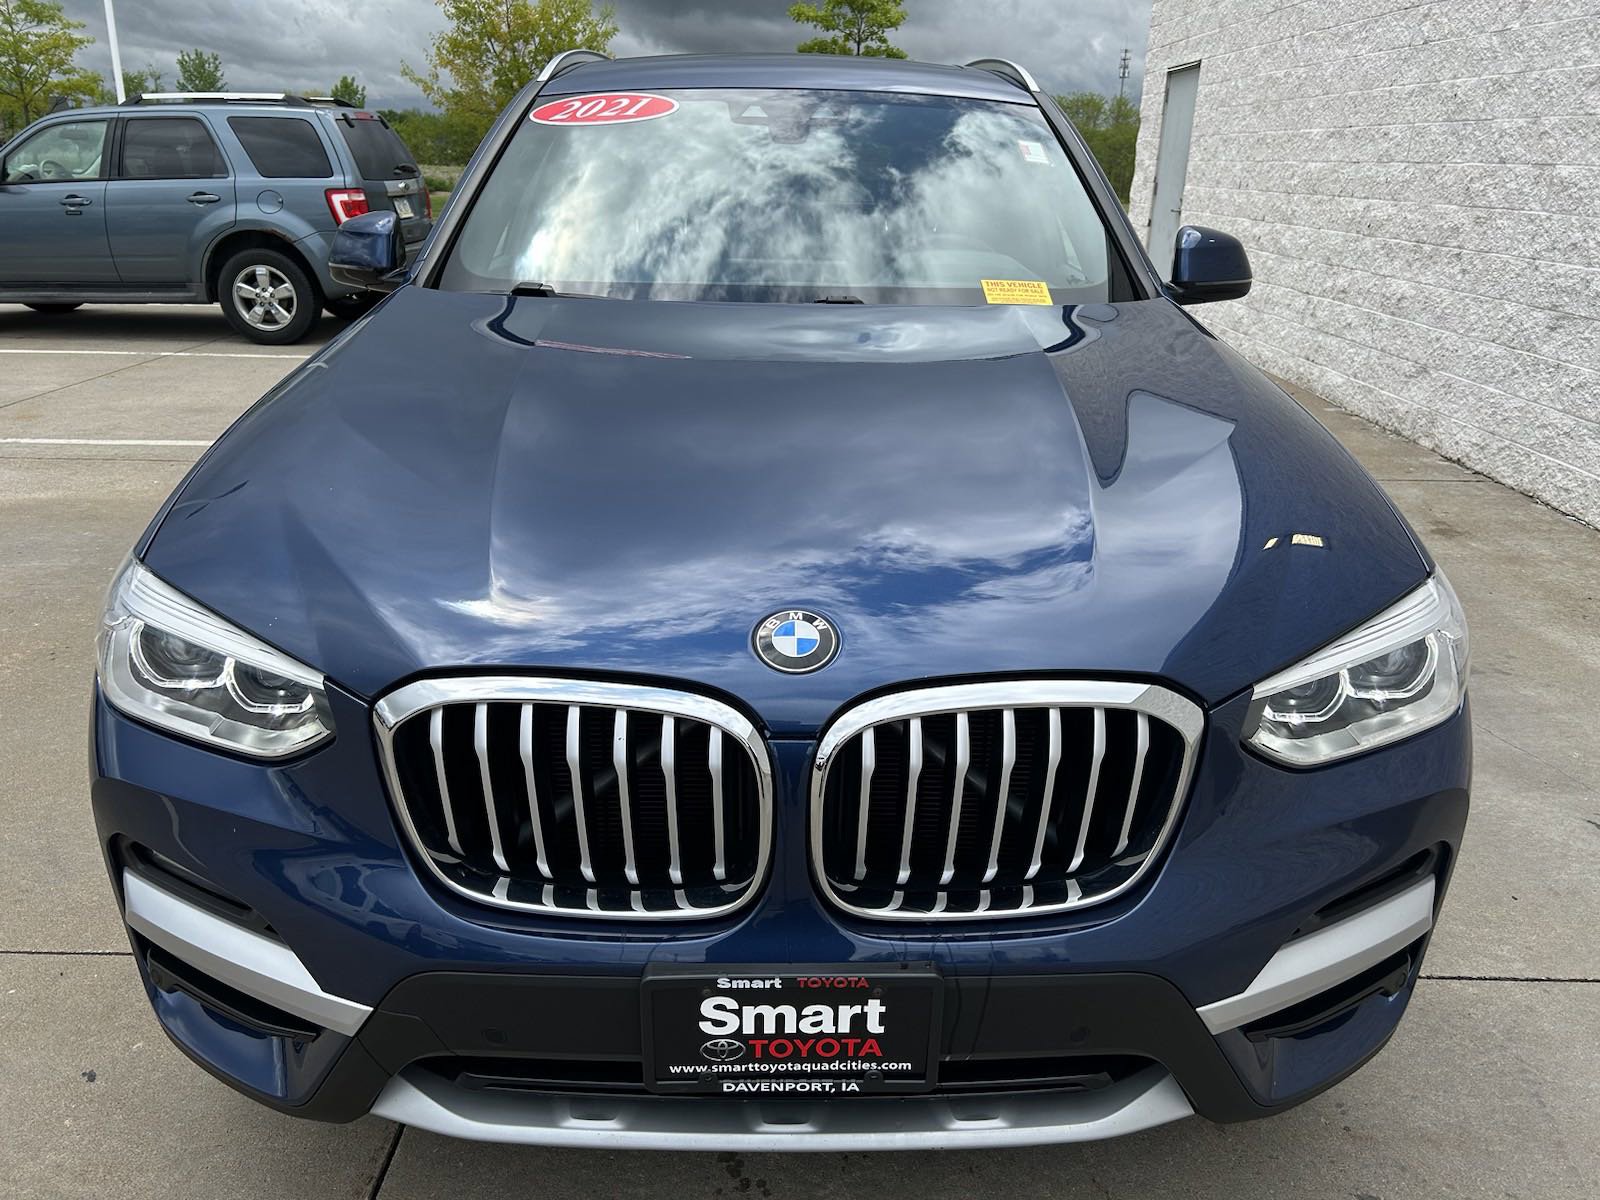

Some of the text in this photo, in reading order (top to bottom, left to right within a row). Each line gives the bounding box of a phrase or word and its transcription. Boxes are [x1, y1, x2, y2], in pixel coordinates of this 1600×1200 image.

[548, 98, 653, 121] 2021
[765, 612, 828, 630] BMW
[717, 977, 869, 989] Smart TOYOTA
[699, 996, 886, 1035] Smart
[749, 1038, 883, 1058] TOYOTA
[669, 1060, 912, 1074] www.smarttoyotaquadcities.com
[722, 1082, 860, 1093] DAVENPORT, IA
